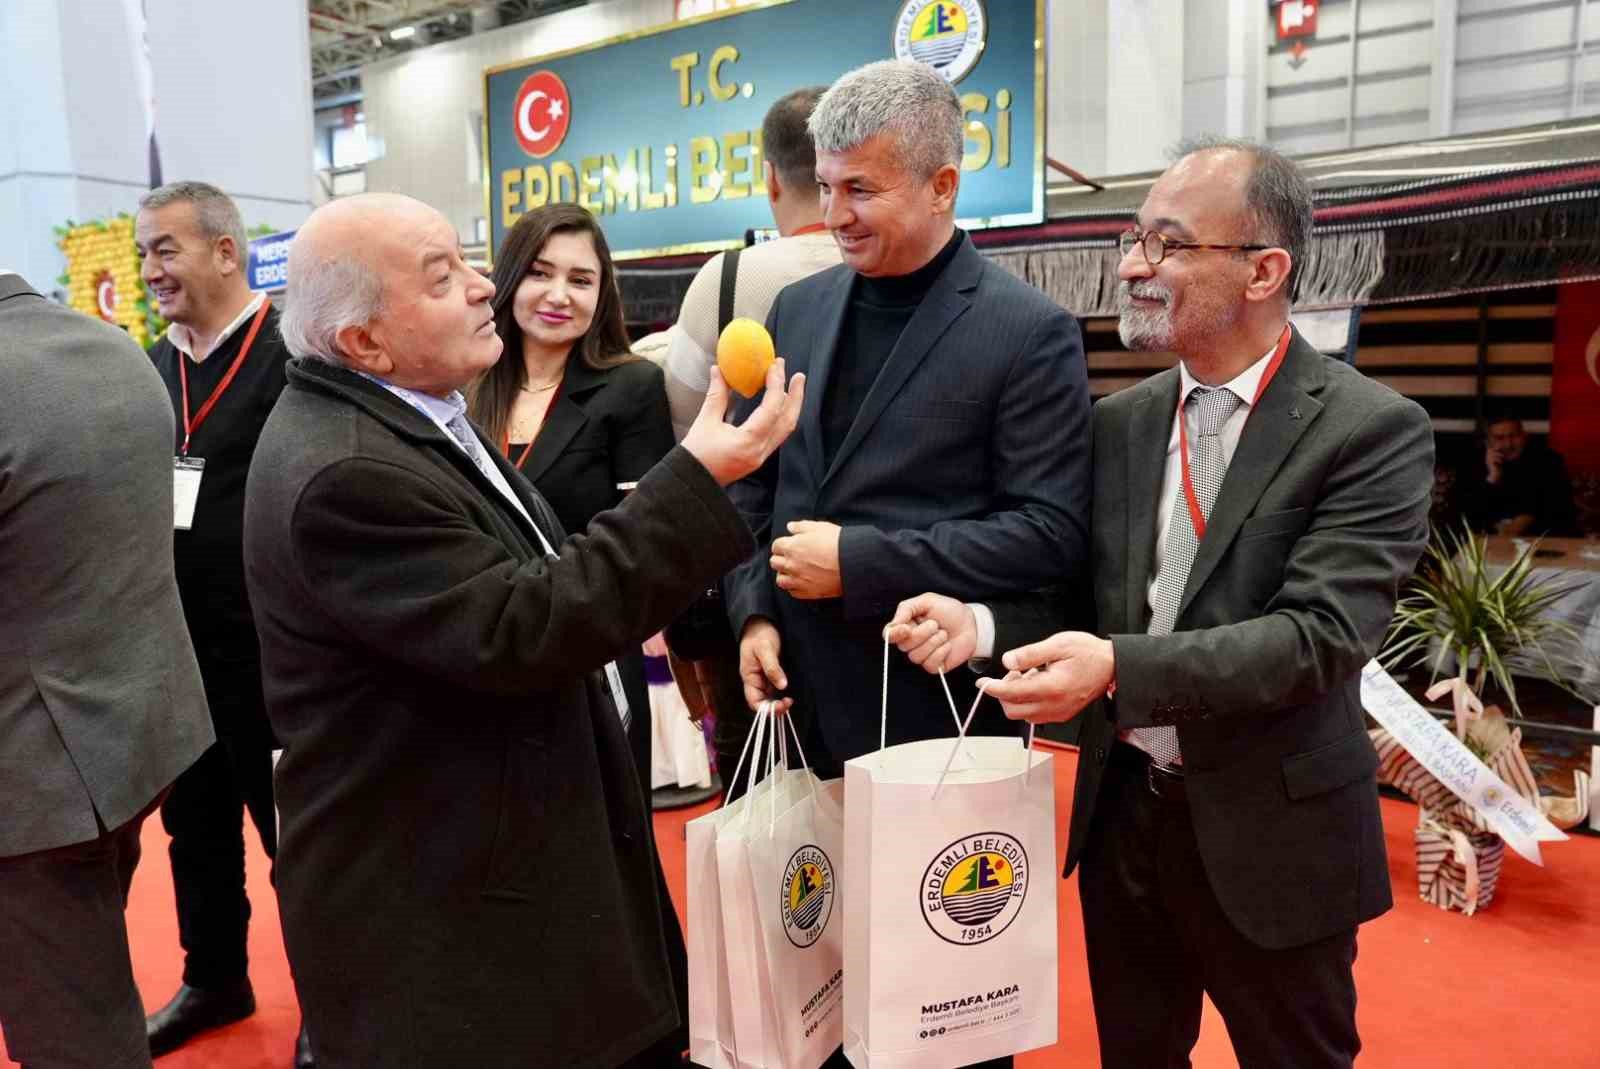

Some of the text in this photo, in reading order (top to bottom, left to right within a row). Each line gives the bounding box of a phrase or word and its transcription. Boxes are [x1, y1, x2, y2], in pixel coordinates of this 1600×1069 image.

[670, 45, 754, 108] T.C.
[961, 924, 992, 940] 1954
[801, 984, 829, 1016] MUSTAFA
[921, 984, 1019, 1015] MUSTAFA KARA
